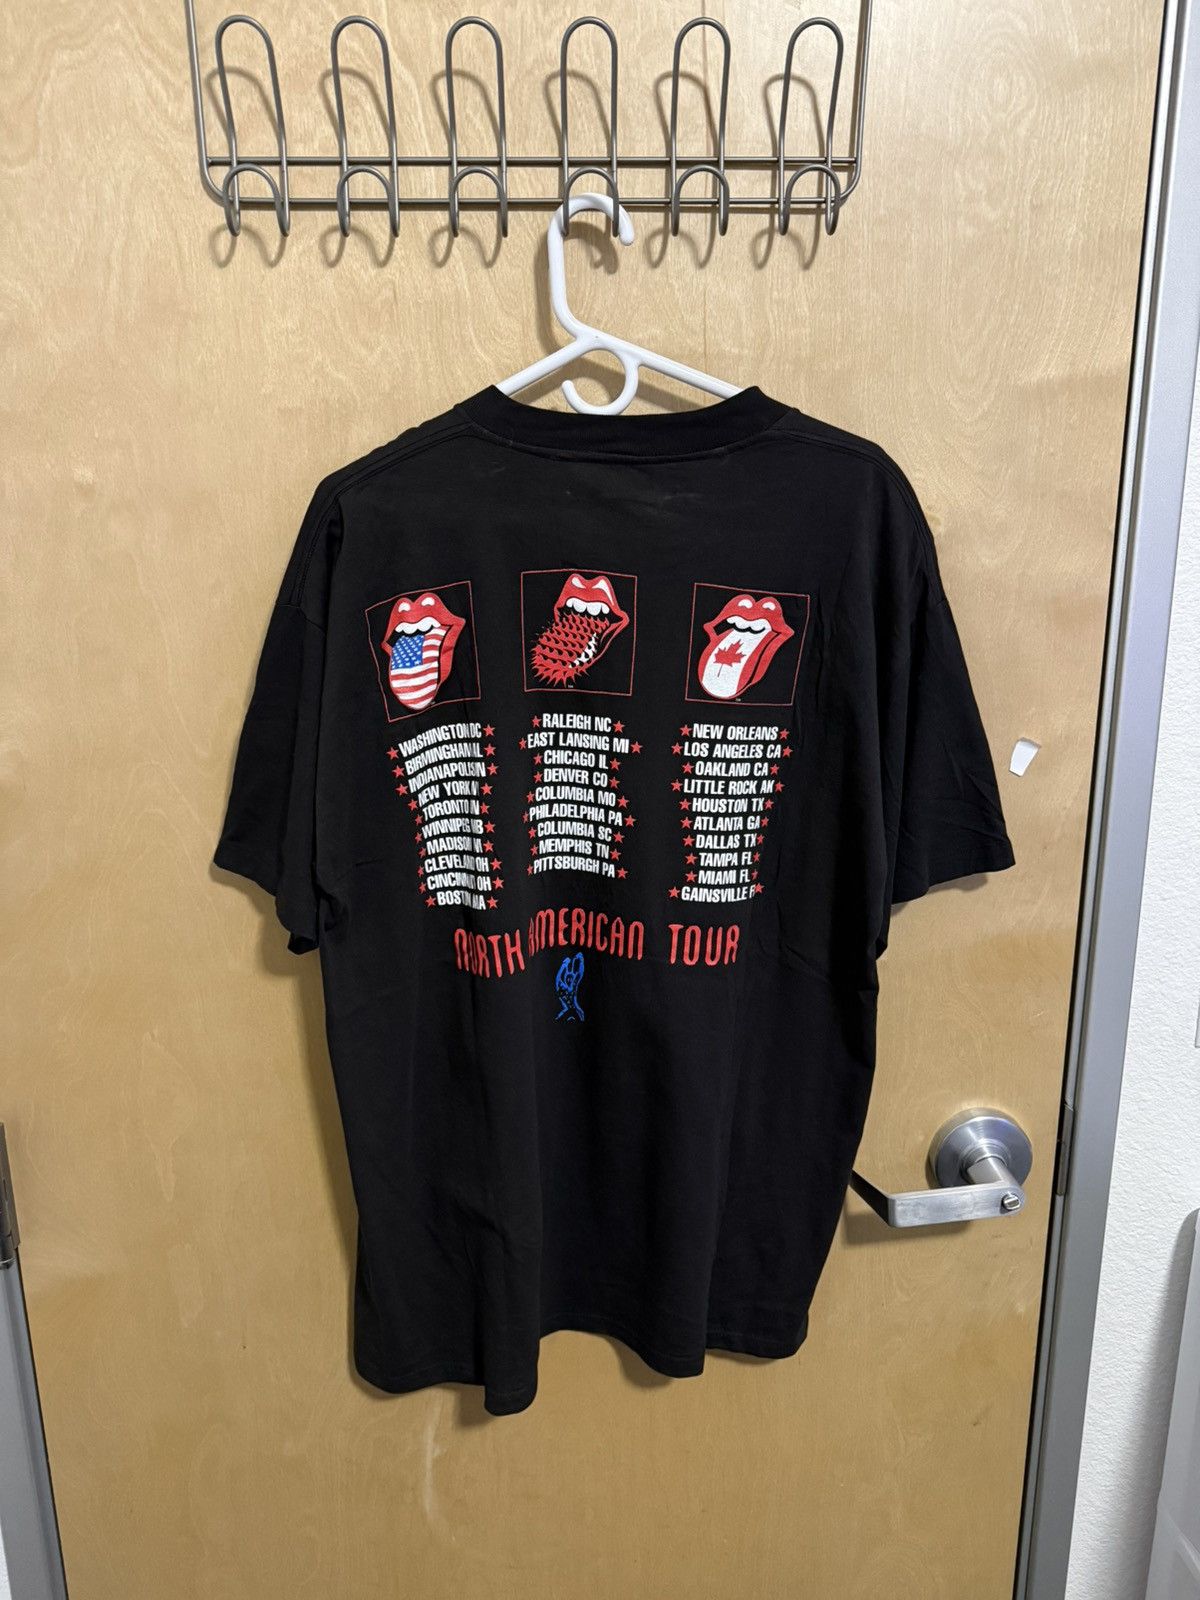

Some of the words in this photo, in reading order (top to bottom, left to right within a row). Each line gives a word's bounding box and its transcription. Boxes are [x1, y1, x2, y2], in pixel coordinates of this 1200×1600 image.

[543, 713, 591, 730] RALEIGH
[594, 716, 611, 732] NC
[692, 723, 724, 740] NEW
[727, 726, 778, 741] ORLEANS
[398, 723, 470, 758] WASHINGTON
[470, 723, 482, 738] DC
[527, 732, 555, 748] EAST
[559, 733, 609, 751] LANSING
[613, 738, 630, 753] MI
[544, 750, 595, 767] CHICAGO
[599, 754, 609, 769] IL
[684, 742, 709, 758] LOS
[712, 744, 763, 759] ANGELES
[767, 744, 782, 758] CA
[408, 763, 476, 793] INDIANAPOLIS
[544, 769, 589, 784] DENVER
[593, 772, 608, 787] CO
[695, 761, 751, 777] OAKLAND
[754, 762, 768, 777] CA
[418, 784, 440, 806] NEW
[443, 781, 471, 797] YORK
[535, 786, 594, 803] COLUMBIA
[598, 791, 616, 807] MO
[683, 779, 725, 795] LITTLE
[729, 780, 757, 795] ROCK
[423, 800, 469, 821] TORONTO
[529, 804, 605, 822] PHILADELPHIA
[608, 811, 623, 826] PA
[692, 798, 748, 813] HOUSTON
[752, 798, 764, 811] TX
[422, 819, 470, 839] WINNIPEG
[537, 821, 595, 838] COLUMBIA
[598, 826, 612, 841] SC
[693, 817, 743, 832] ATLANTA
[747, 816, 760, 830] GA
[426, 837, 472, 855] MADISON
[539, 839, 592, 855] MEMPHIS
[596, 843, 610, 859] TN
[696, 835, 740, 849] DALLAS
[744, 834, 757, 848] TX
[424, 854, 475, 873] CLEVELAND
[476, 858, 490, 872] OH
[534, 856, 599, 874] PITTSBURGH
[602, 862, 615, 878] PA
[699, 852, 738, 867] TAMPA
[742, 852, 752, 866] FL
[477, 876, 491, 891] OH
[698, 869, 737, 885] MIAMI
[739, 869, 750, 883] FL
[681, 886, 748, 903] GAINSVILLE
[454, 928, 526, 978] NORTH
[528, 908, 645, 960] AMERICAN
[668, 923, 740, 966] TOUR
